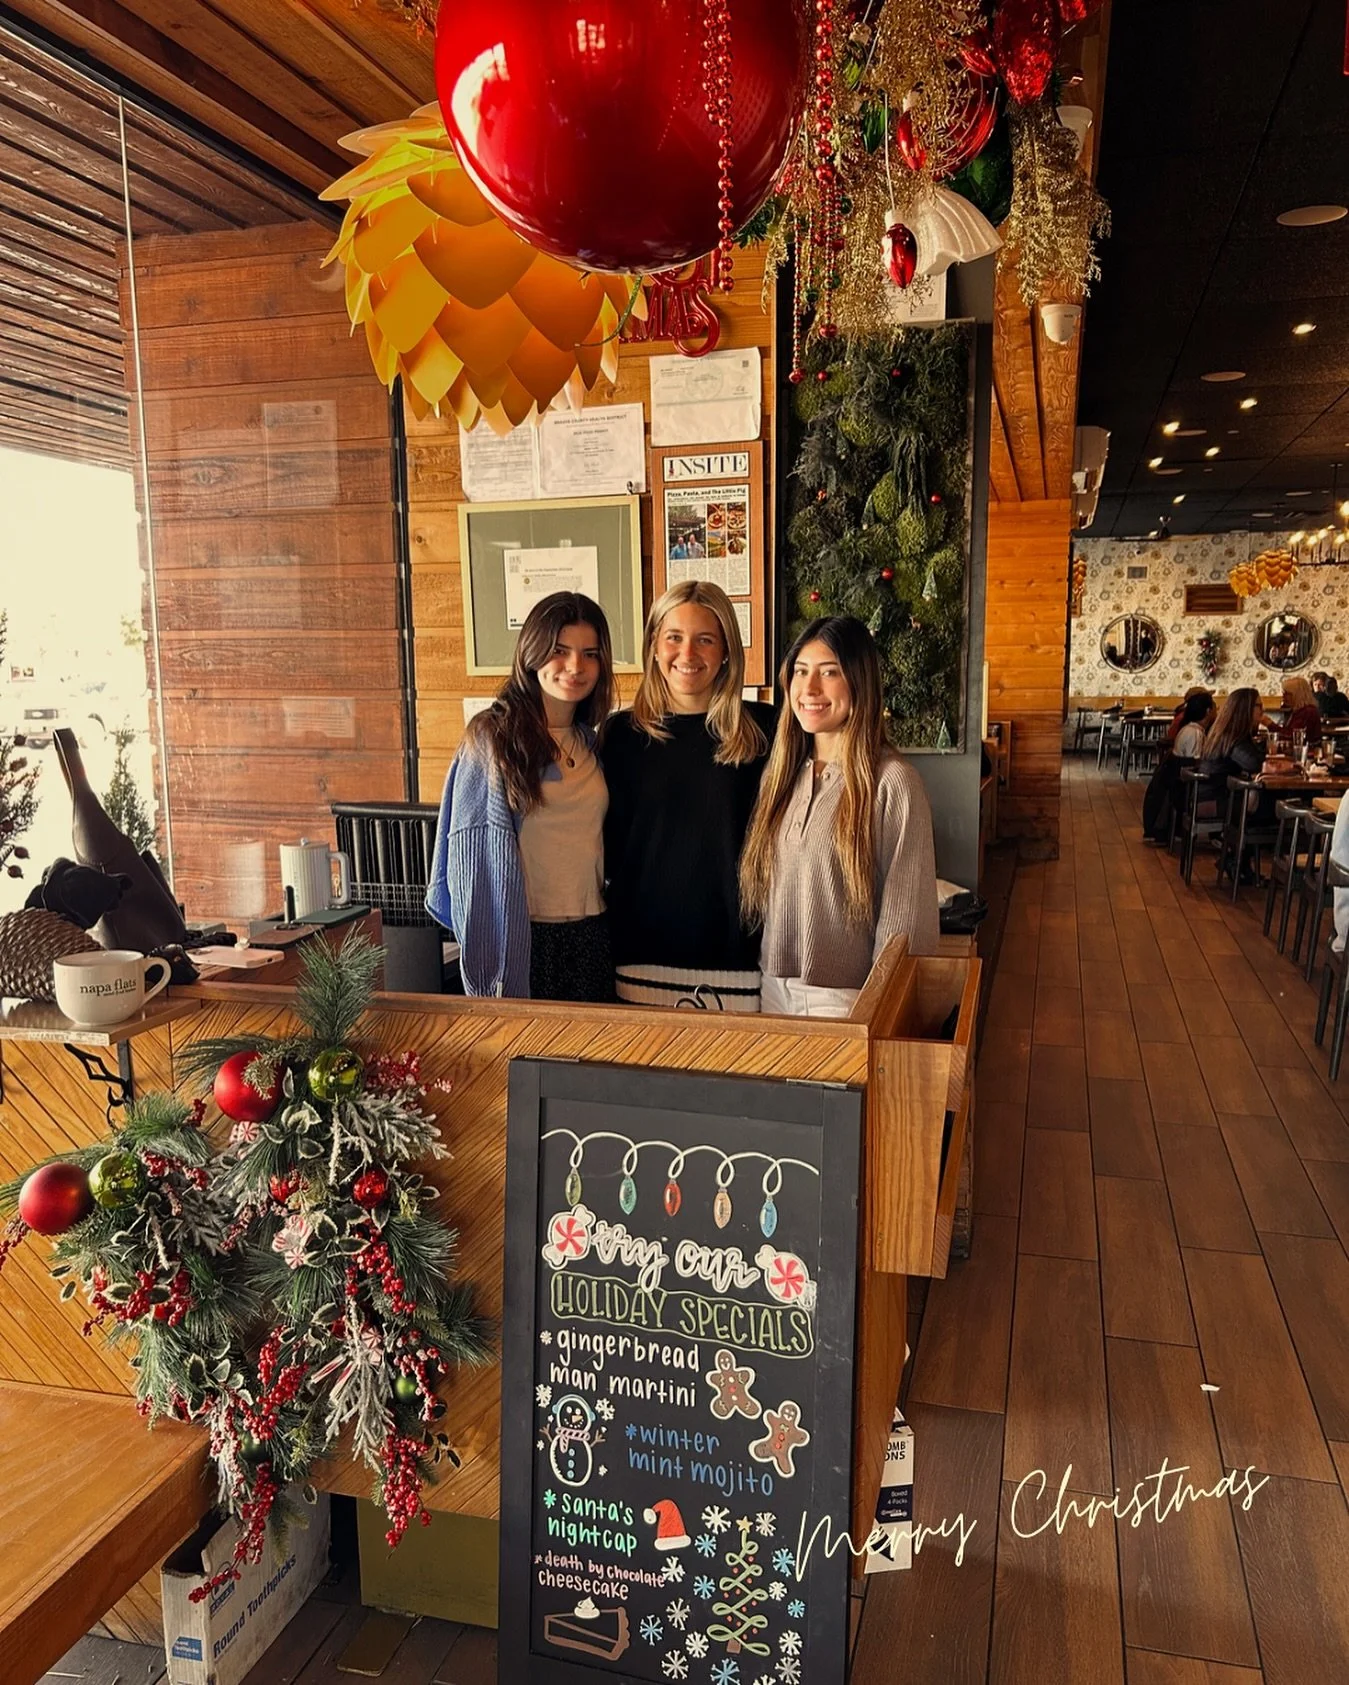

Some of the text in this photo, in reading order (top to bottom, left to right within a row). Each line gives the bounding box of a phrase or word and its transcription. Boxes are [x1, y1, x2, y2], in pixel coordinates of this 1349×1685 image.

[668, 456, 747, 475] INSITE
[80, 983, 112, 996] napa
[114, 978, 137, 991] flats
[592, 1220, 760, 1292] try our
[556, 1275, 809, 1351] HOLIDAY SPECIALS
[557, 1326, 700, 1373] gingerbread
[550, 1362, 697, 1408] man martini
[640, 1424, 720, 1455] winter
[628, 1448, 773, 1496] mint mojito
[544, 1549, 583, 1572] death
[588, 1559, 605, 1579] by
[213, 1610, 246, 1659] Round
[247, 1553, 297, 1617] Toothpicks
